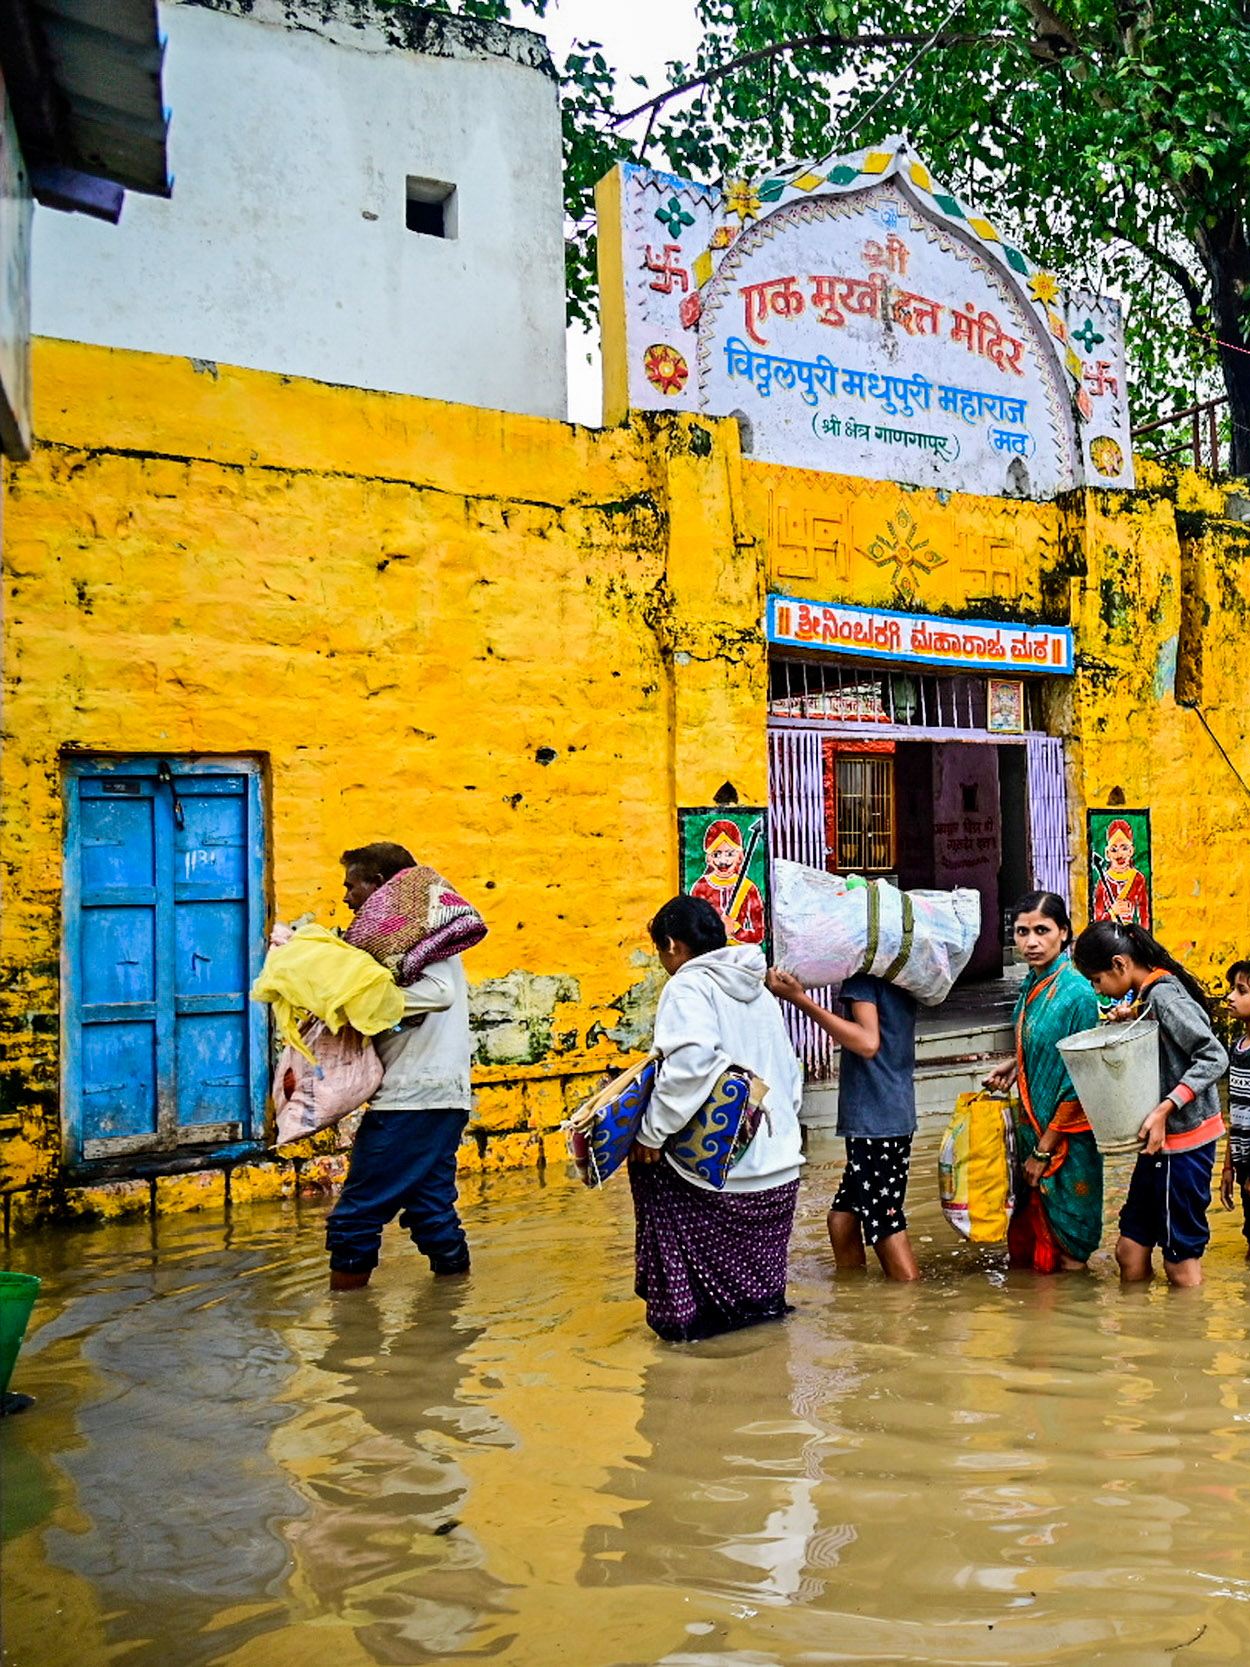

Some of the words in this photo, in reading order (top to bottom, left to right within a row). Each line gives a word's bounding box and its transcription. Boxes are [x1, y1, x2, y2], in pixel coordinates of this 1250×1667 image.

[862, 233, 911, 275] श्री
[739, 275, 805, 346] एक
[950, 303, 1026, 376] मंदिर
[841, 368, 933, 417] मधुपुरी
[938, 384, 1028, 425] महाराज
[845, 417, 871, 442] क्षेत्र
[911, 622, 1007, 661] ಮಹಾರಾಜ
[1010, 632, 1050, 663] ಮಠ
